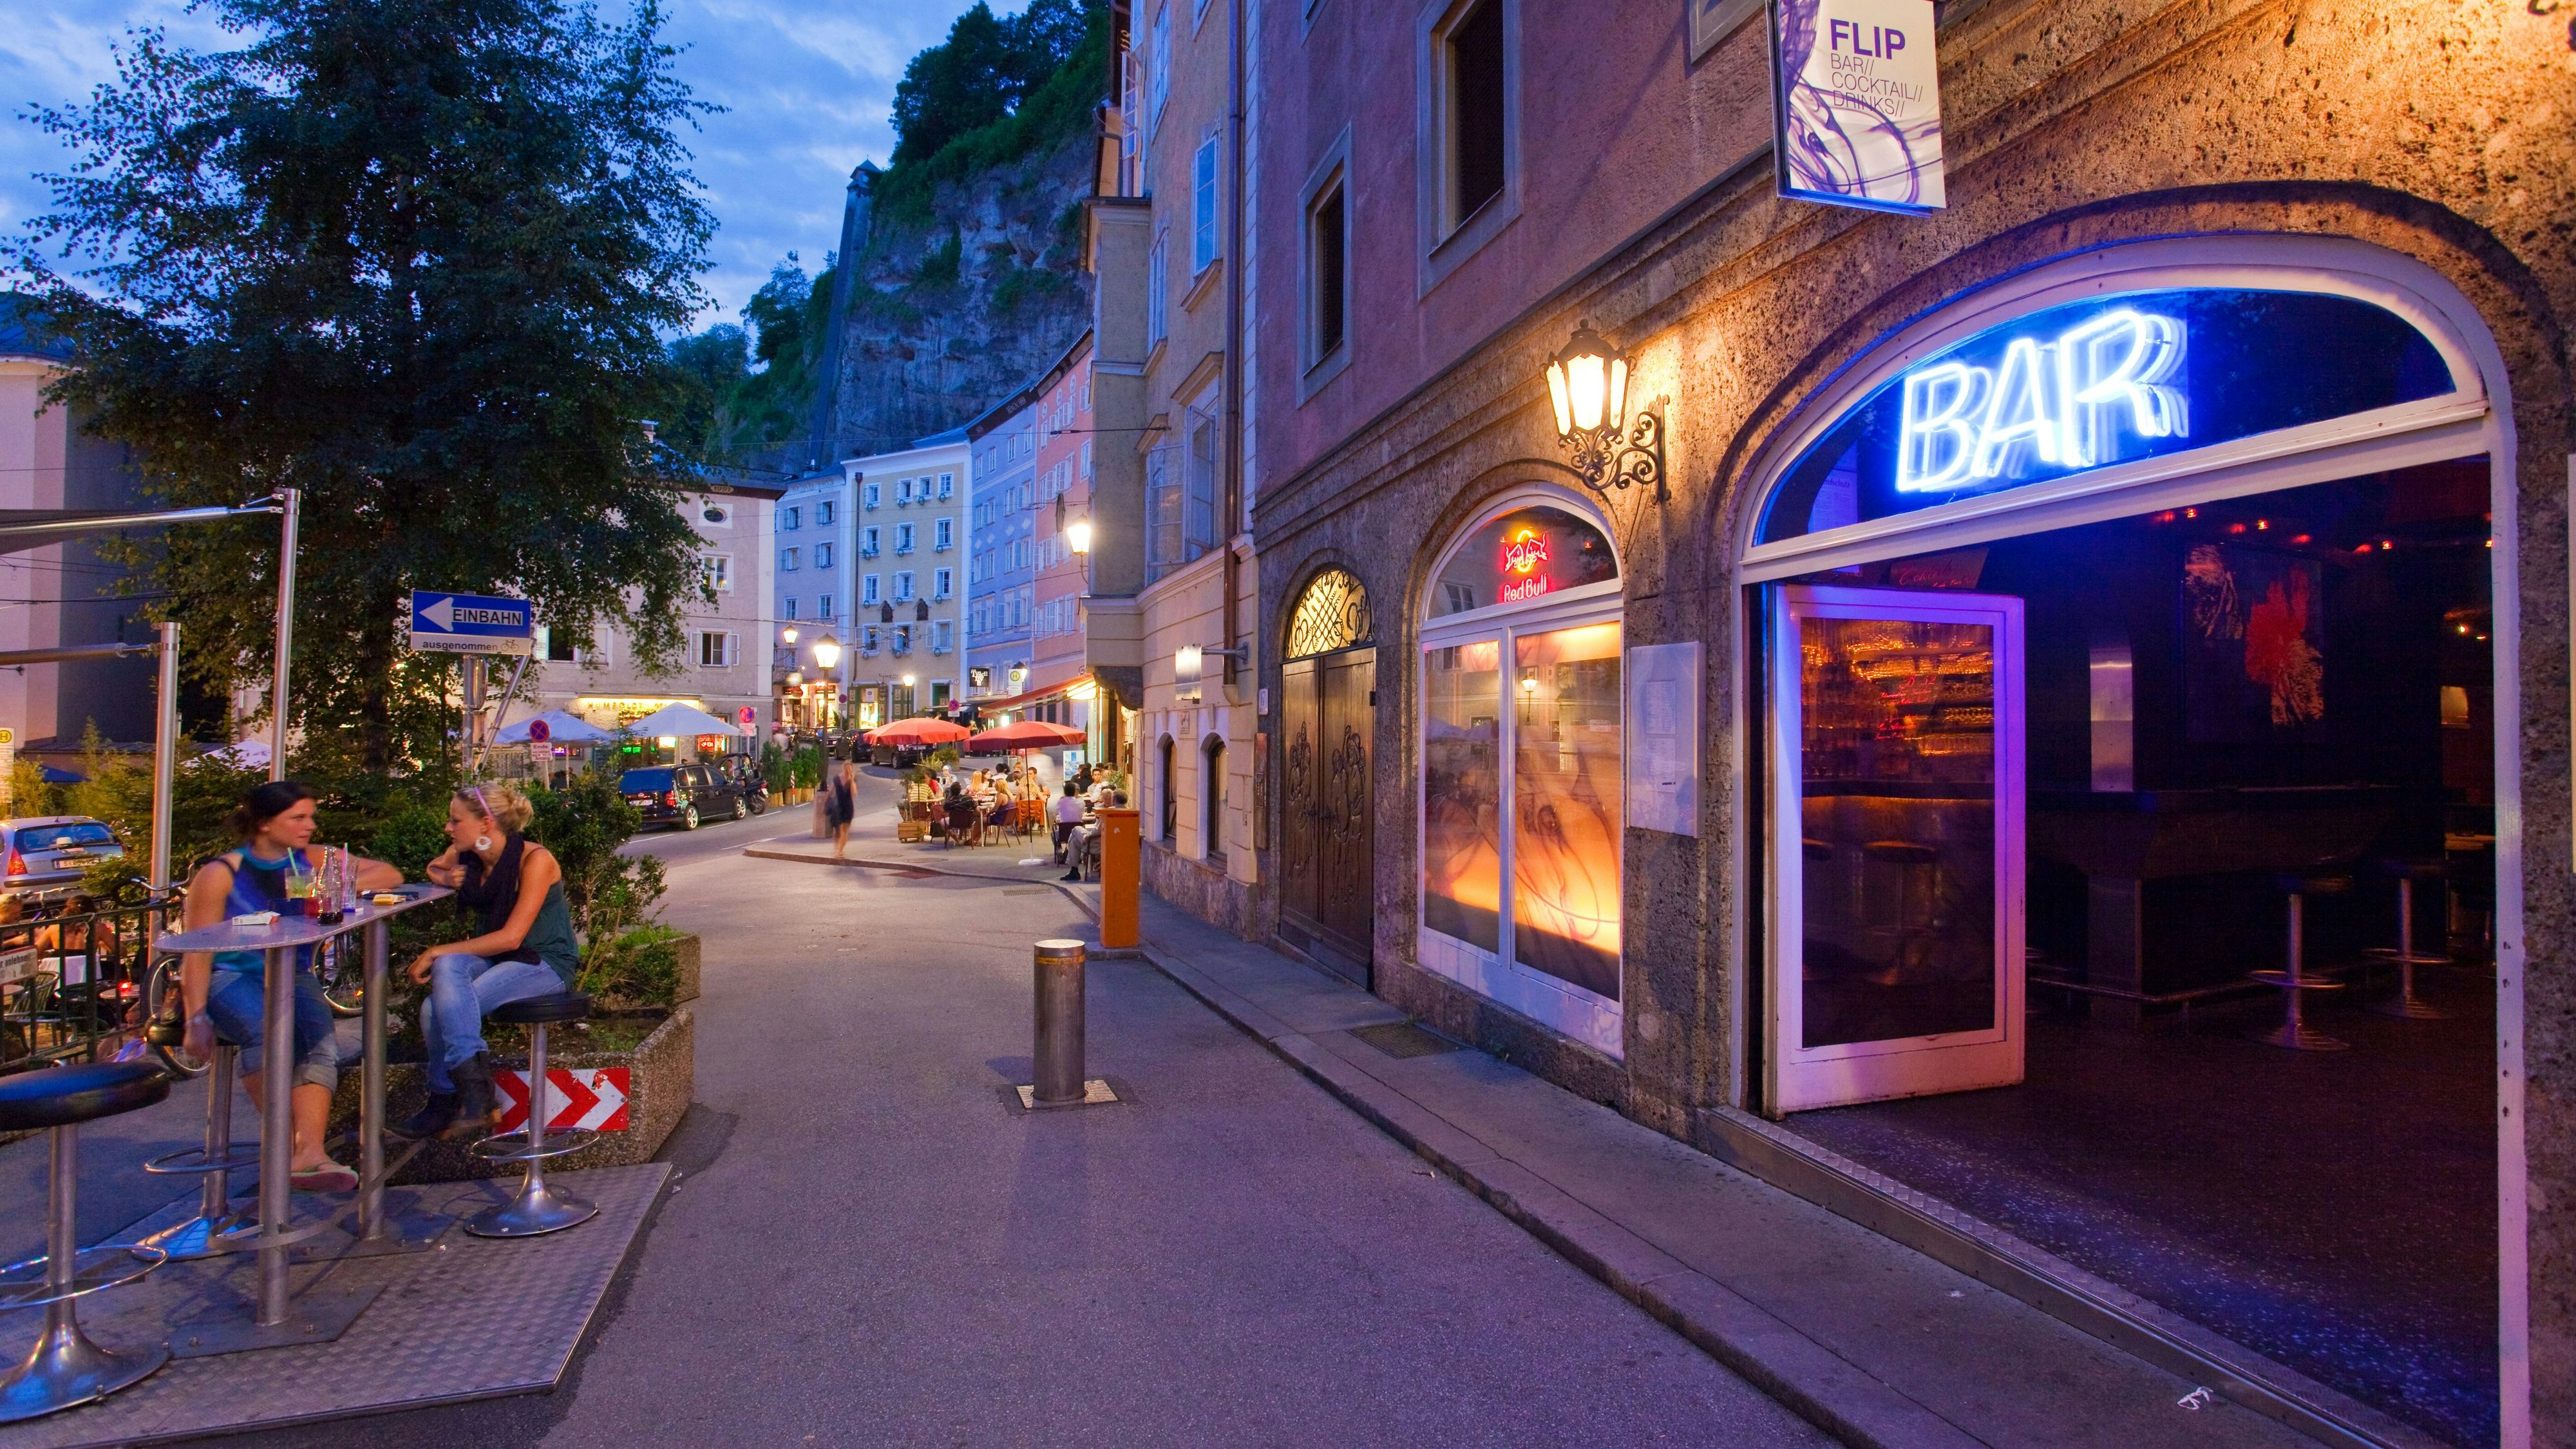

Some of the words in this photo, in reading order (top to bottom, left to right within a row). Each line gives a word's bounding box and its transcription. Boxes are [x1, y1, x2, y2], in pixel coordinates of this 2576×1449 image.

[1830, 19, 1906, 61] FLIP
[1830, 53, 1874, 75] BAR//
[1831, 71, 1924, 103] COCKTAIL//
[1896, 309, 2169, 492] BAR
[1504, 580, 1524, 603] Red
[1526, 573, 1547, 598] Bull
[453, 609, 522, 625] EINBAHN
[422, 641, 498, 652] ausgenommen
